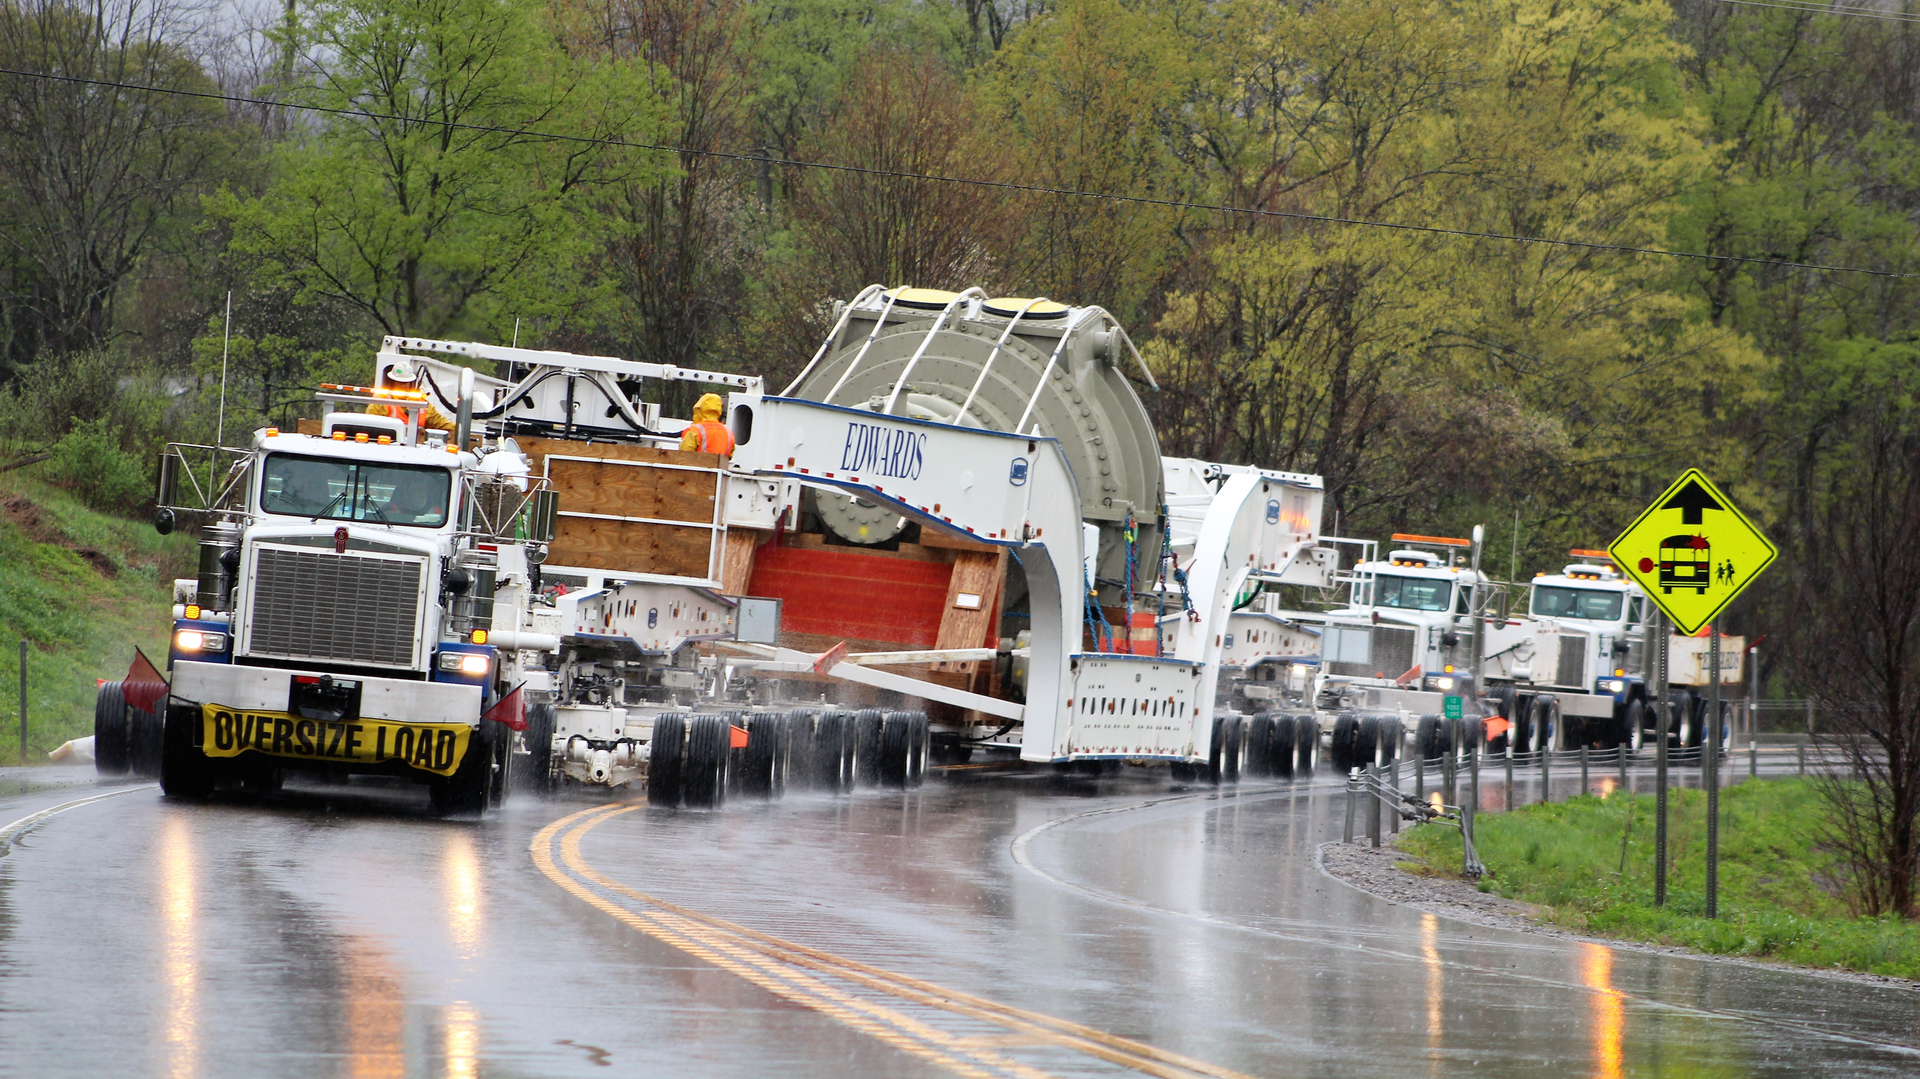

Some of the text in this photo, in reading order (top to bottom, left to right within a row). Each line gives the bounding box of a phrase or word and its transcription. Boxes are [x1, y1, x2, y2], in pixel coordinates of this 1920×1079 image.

[839, 422, 927, 481] EDWARDS
[214, 710, 457, 770] OVERSIZE LOAD
